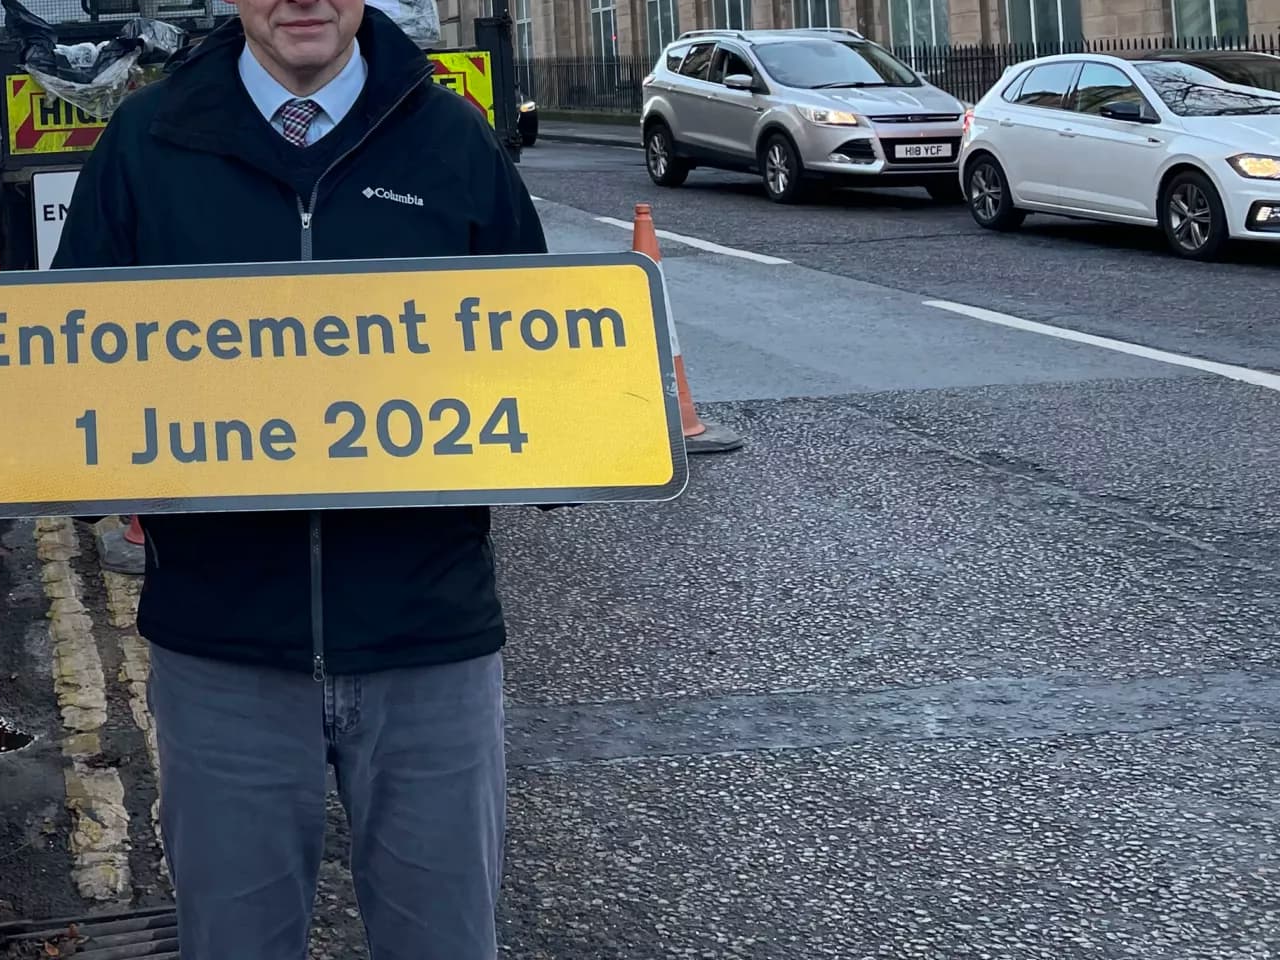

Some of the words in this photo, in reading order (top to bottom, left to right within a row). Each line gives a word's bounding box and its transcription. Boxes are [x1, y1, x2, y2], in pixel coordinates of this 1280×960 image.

[924, 145, 943, 156] YCF
[374, 187, 424, 206] Columbia
[455, 296, 628, 353] from
[75, 408, 99, 466] 1
[131, 406, 298, 465] June
[323, 396, 529, 459] 2024
